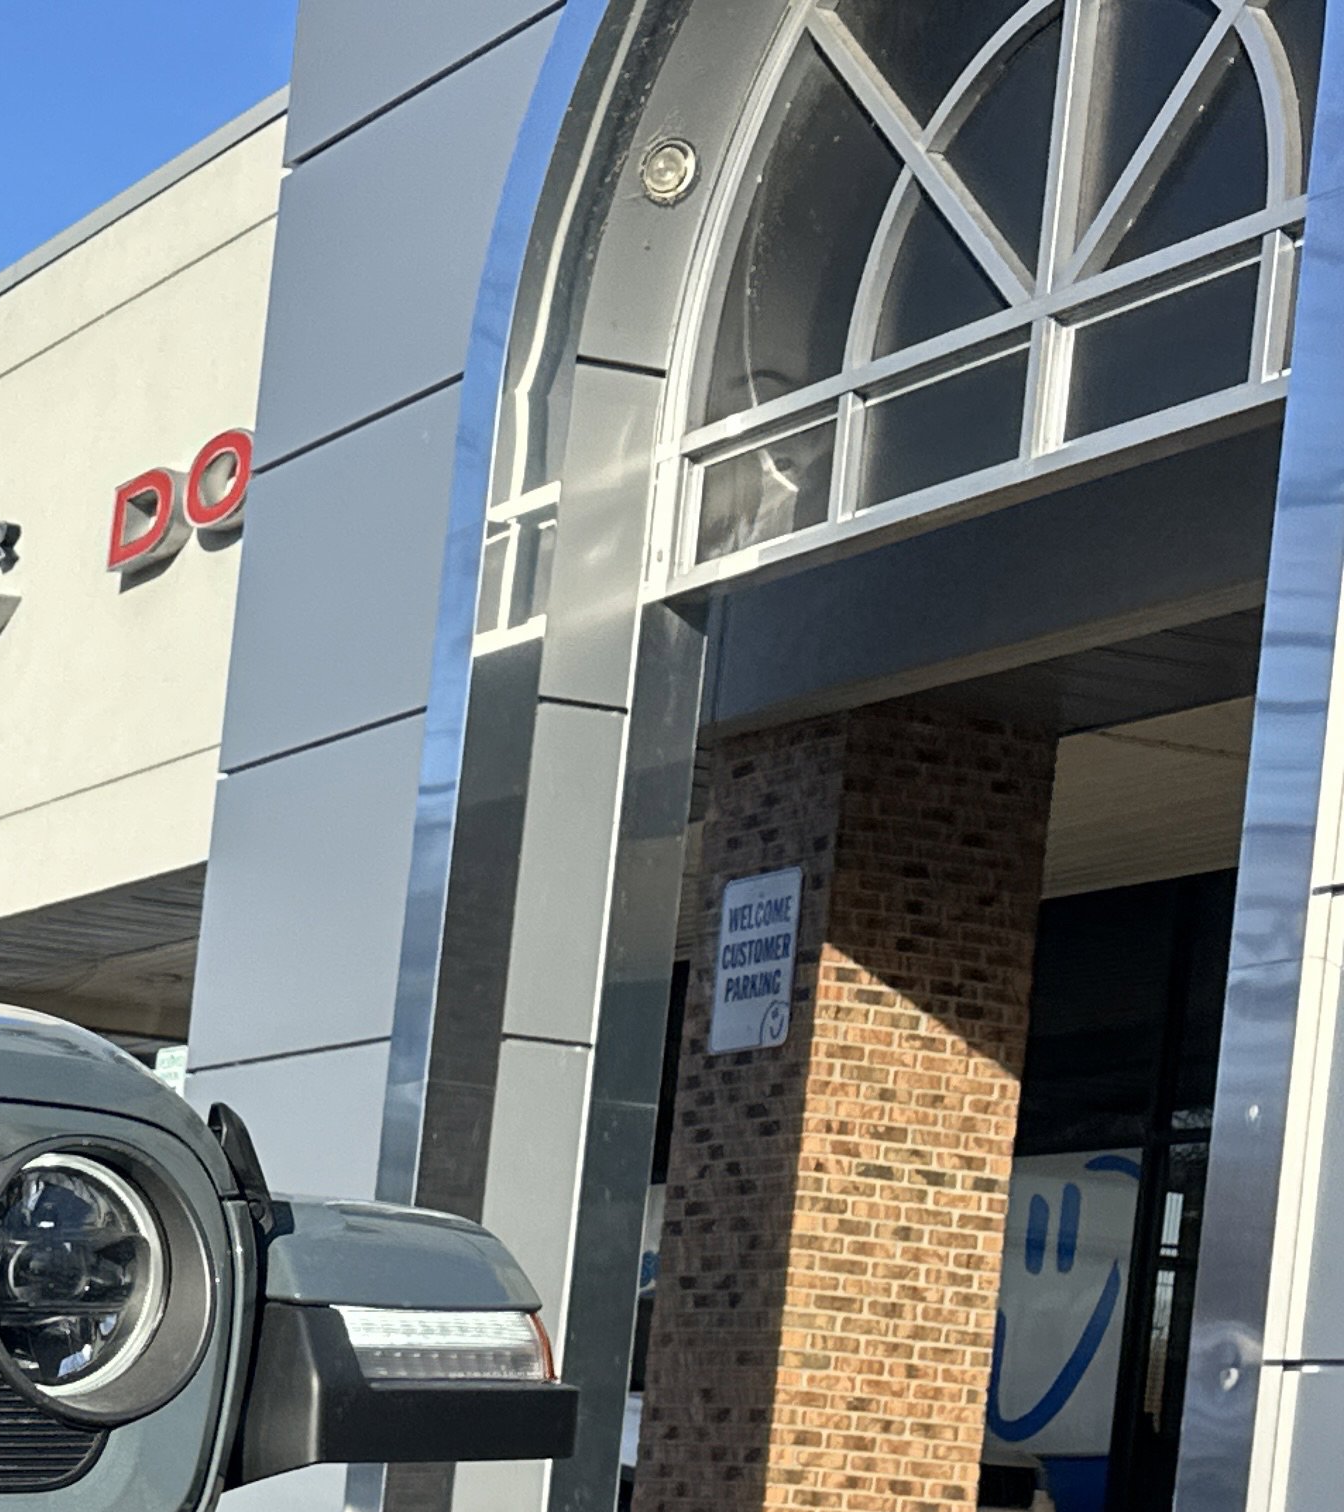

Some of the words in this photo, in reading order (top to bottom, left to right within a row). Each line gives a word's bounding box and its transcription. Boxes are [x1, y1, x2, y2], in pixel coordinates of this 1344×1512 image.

[107, 428, 254, 574] DO
[728, 896, 792, 933] WELCOME
[722, 933, 792, 970] CUSTOMER
[724, 969, 782, 1003] PARKING
